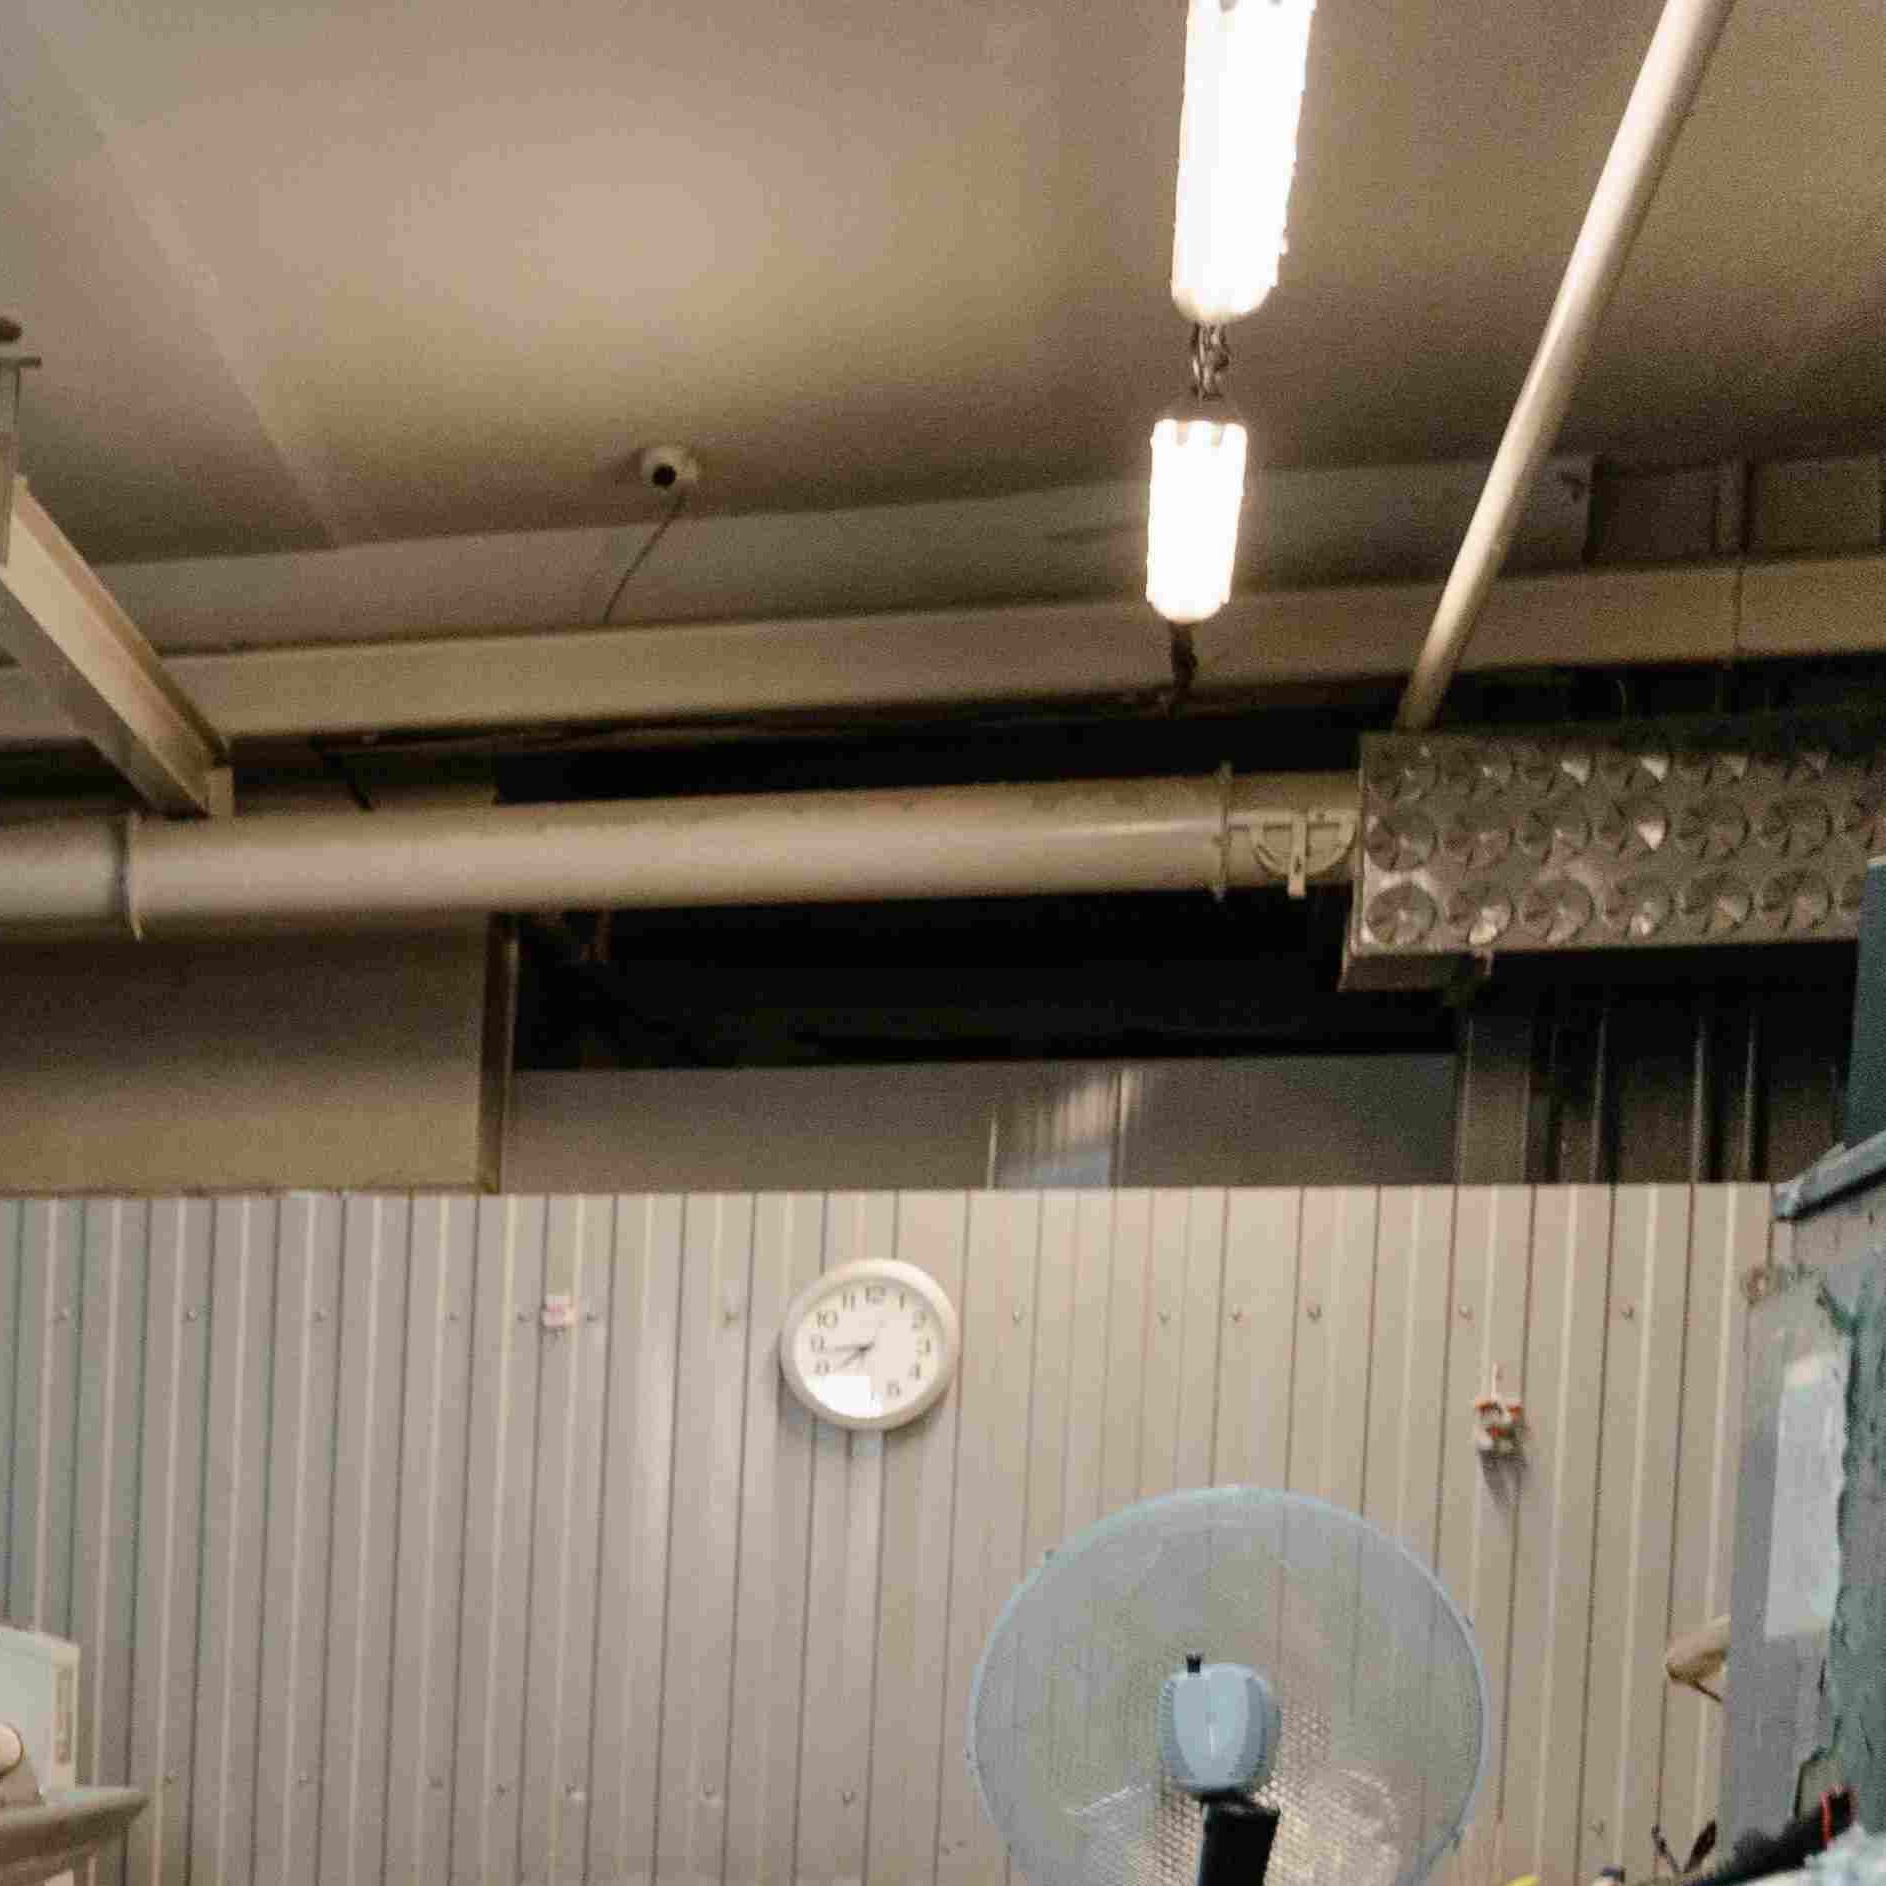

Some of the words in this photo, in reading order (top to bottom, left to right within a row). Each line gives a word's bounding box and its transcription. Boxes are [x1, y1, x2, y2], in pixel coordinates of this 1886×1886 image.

[842, 1291, 856, 1310] 11
[864, 1286, 886, 1304] 12
[817, 1311, 839, 1329] 10
